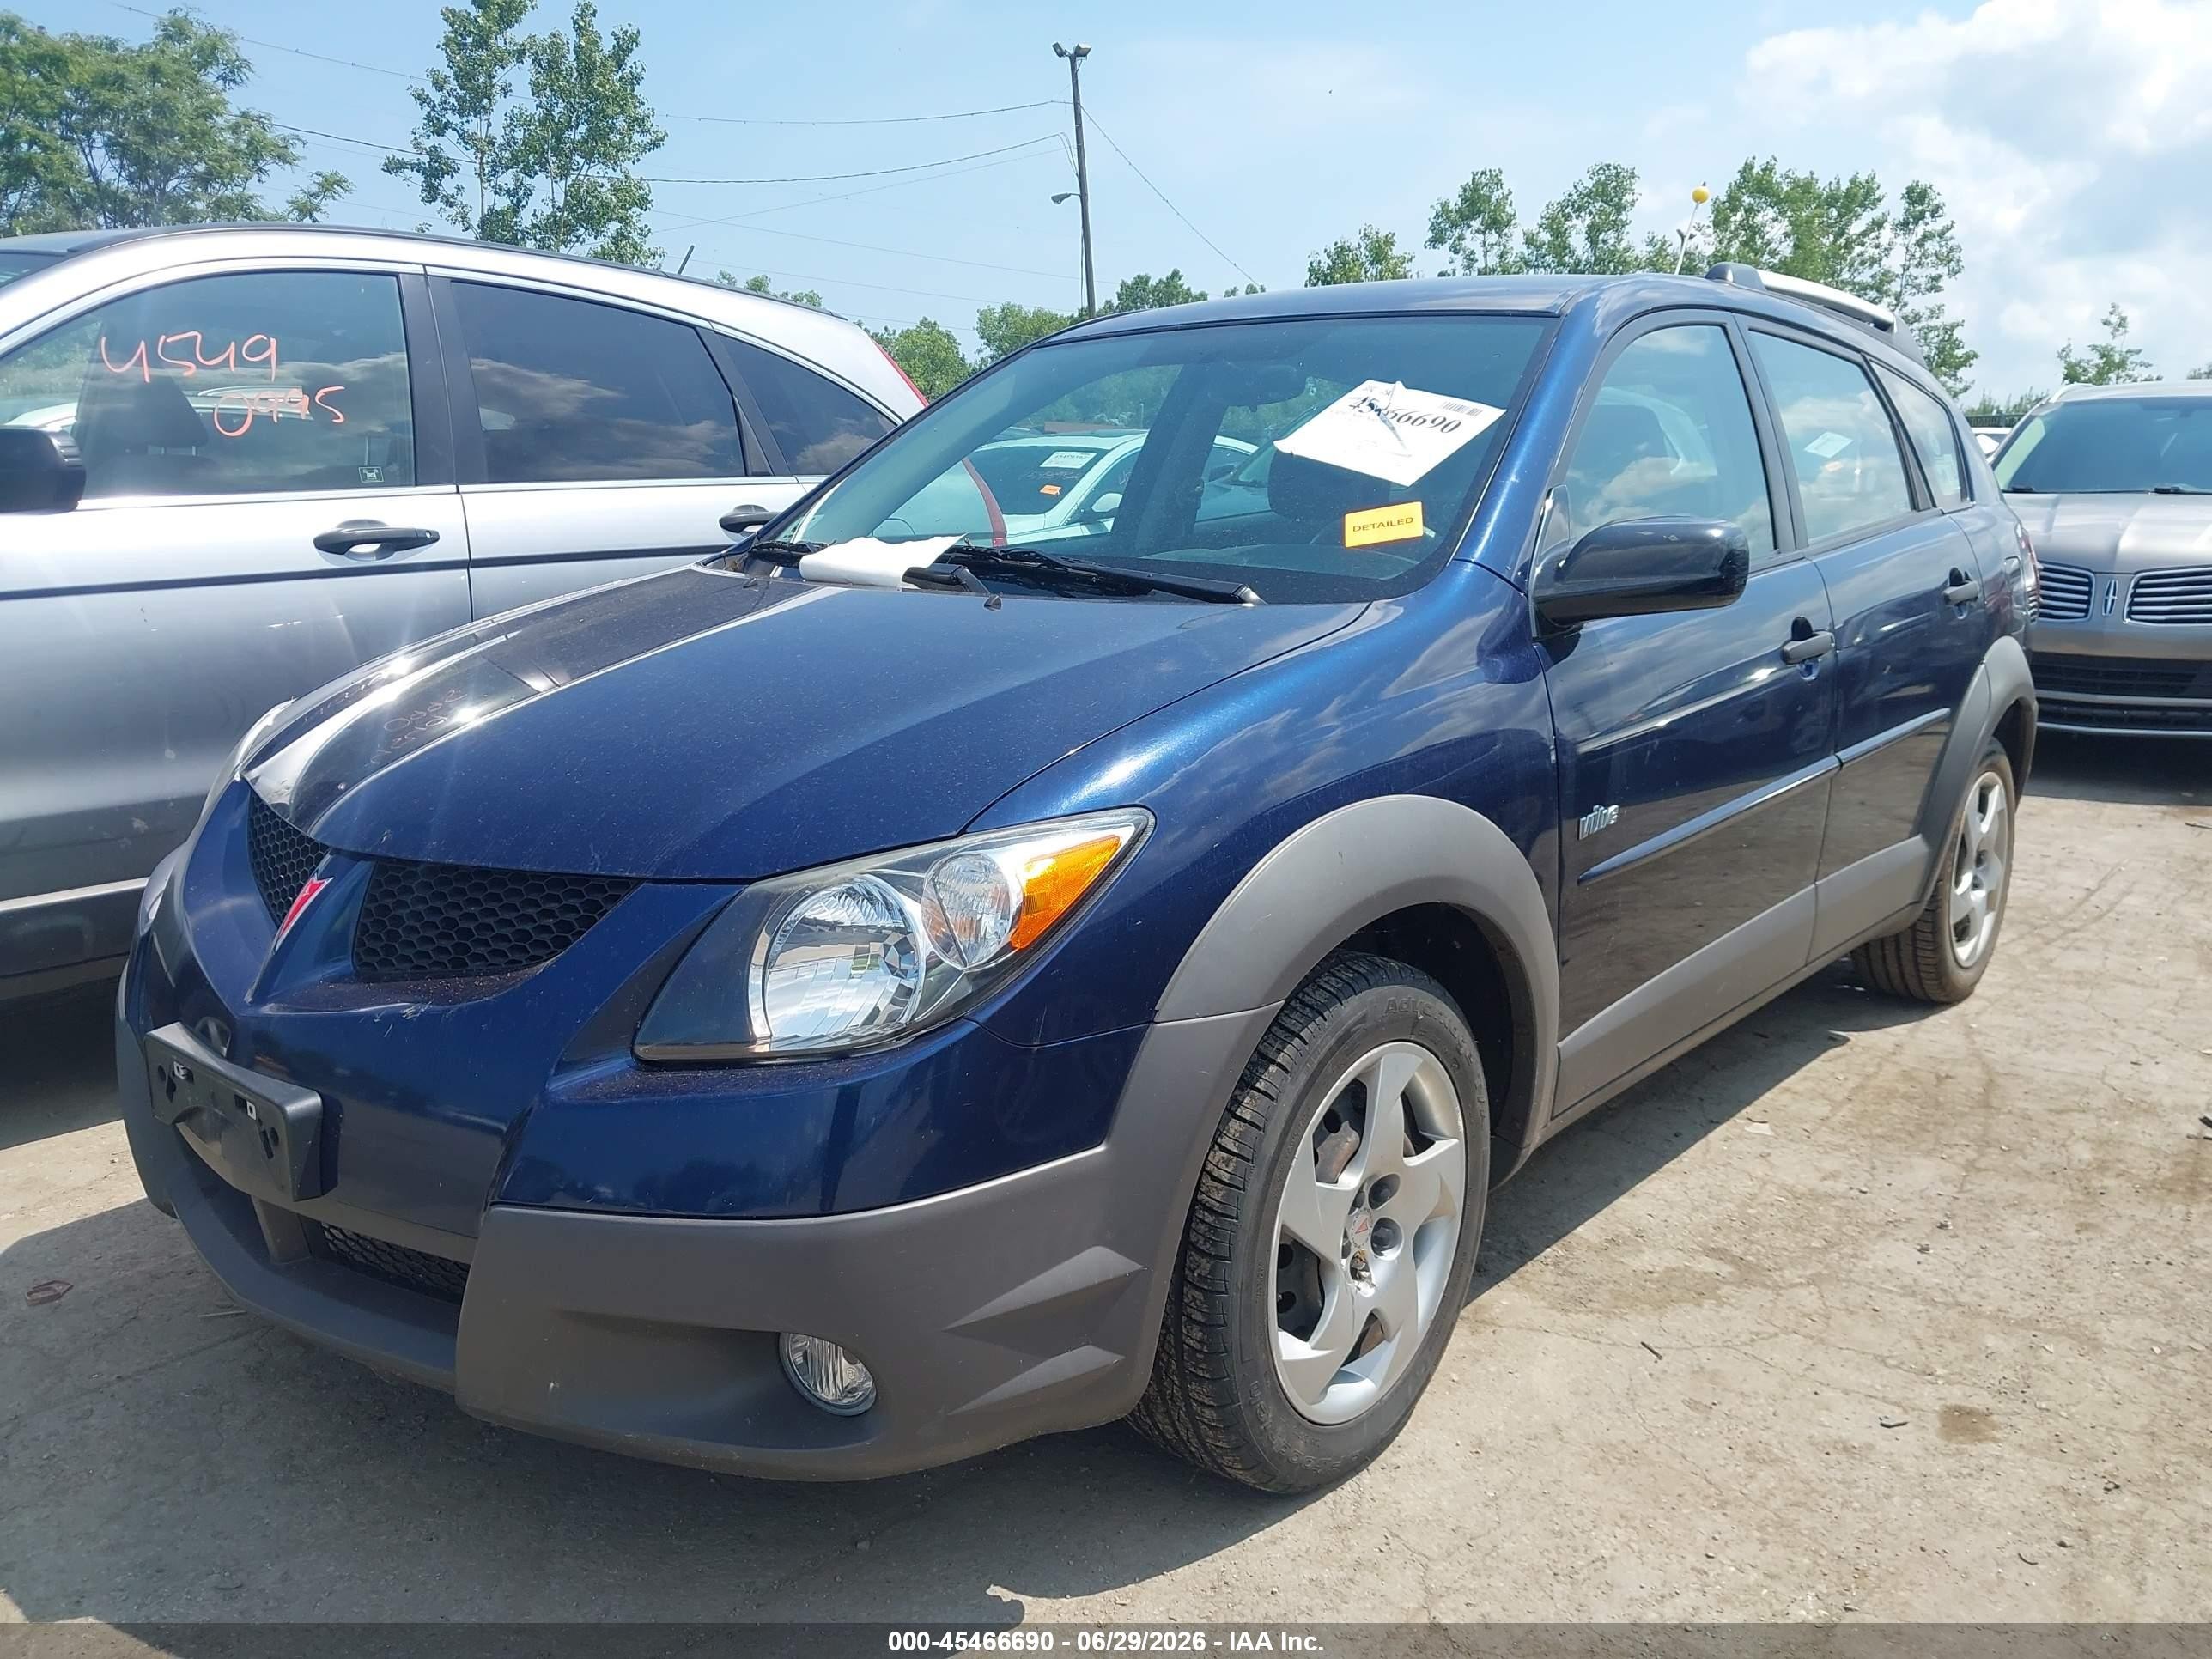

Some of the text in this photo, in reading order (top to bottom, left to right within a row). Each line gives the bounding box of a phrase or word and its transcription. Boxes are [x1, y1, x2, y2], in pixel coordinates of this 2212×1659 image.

[100, 330, 277, 384] 4549
[1348, 396, 1462, 434] 4566690
[1352, 516, 1415, 533] DETAILED
